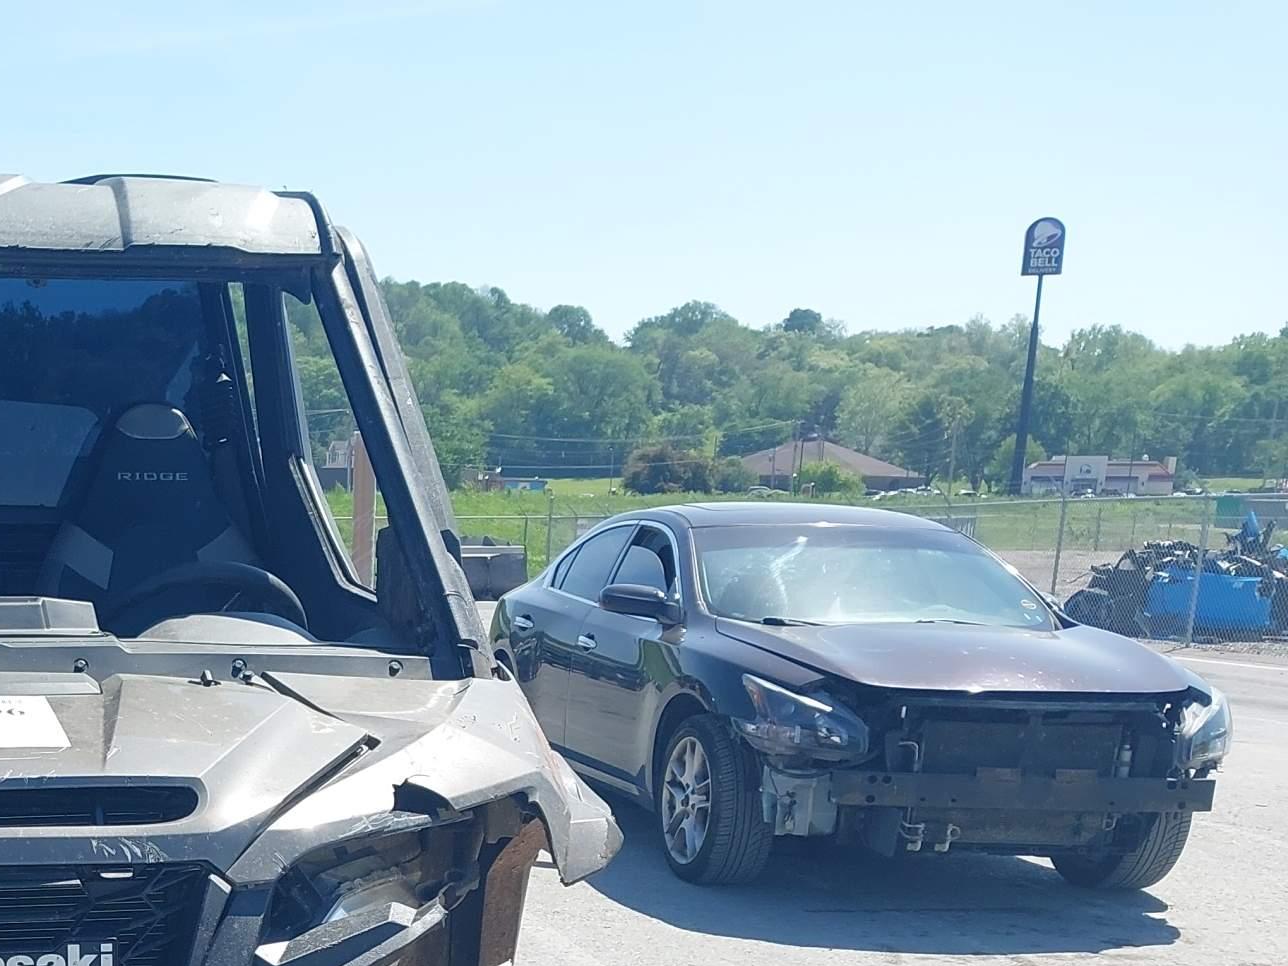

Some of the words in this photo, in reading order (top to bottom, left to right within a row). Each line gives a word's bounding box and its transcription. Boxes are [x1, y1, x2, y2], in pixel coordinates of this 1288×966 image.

[1029, 248, 1060, 258] TACO
[1029, 258, 1058, 267] BELL
[117, 472, 189, 481] RIDGE
